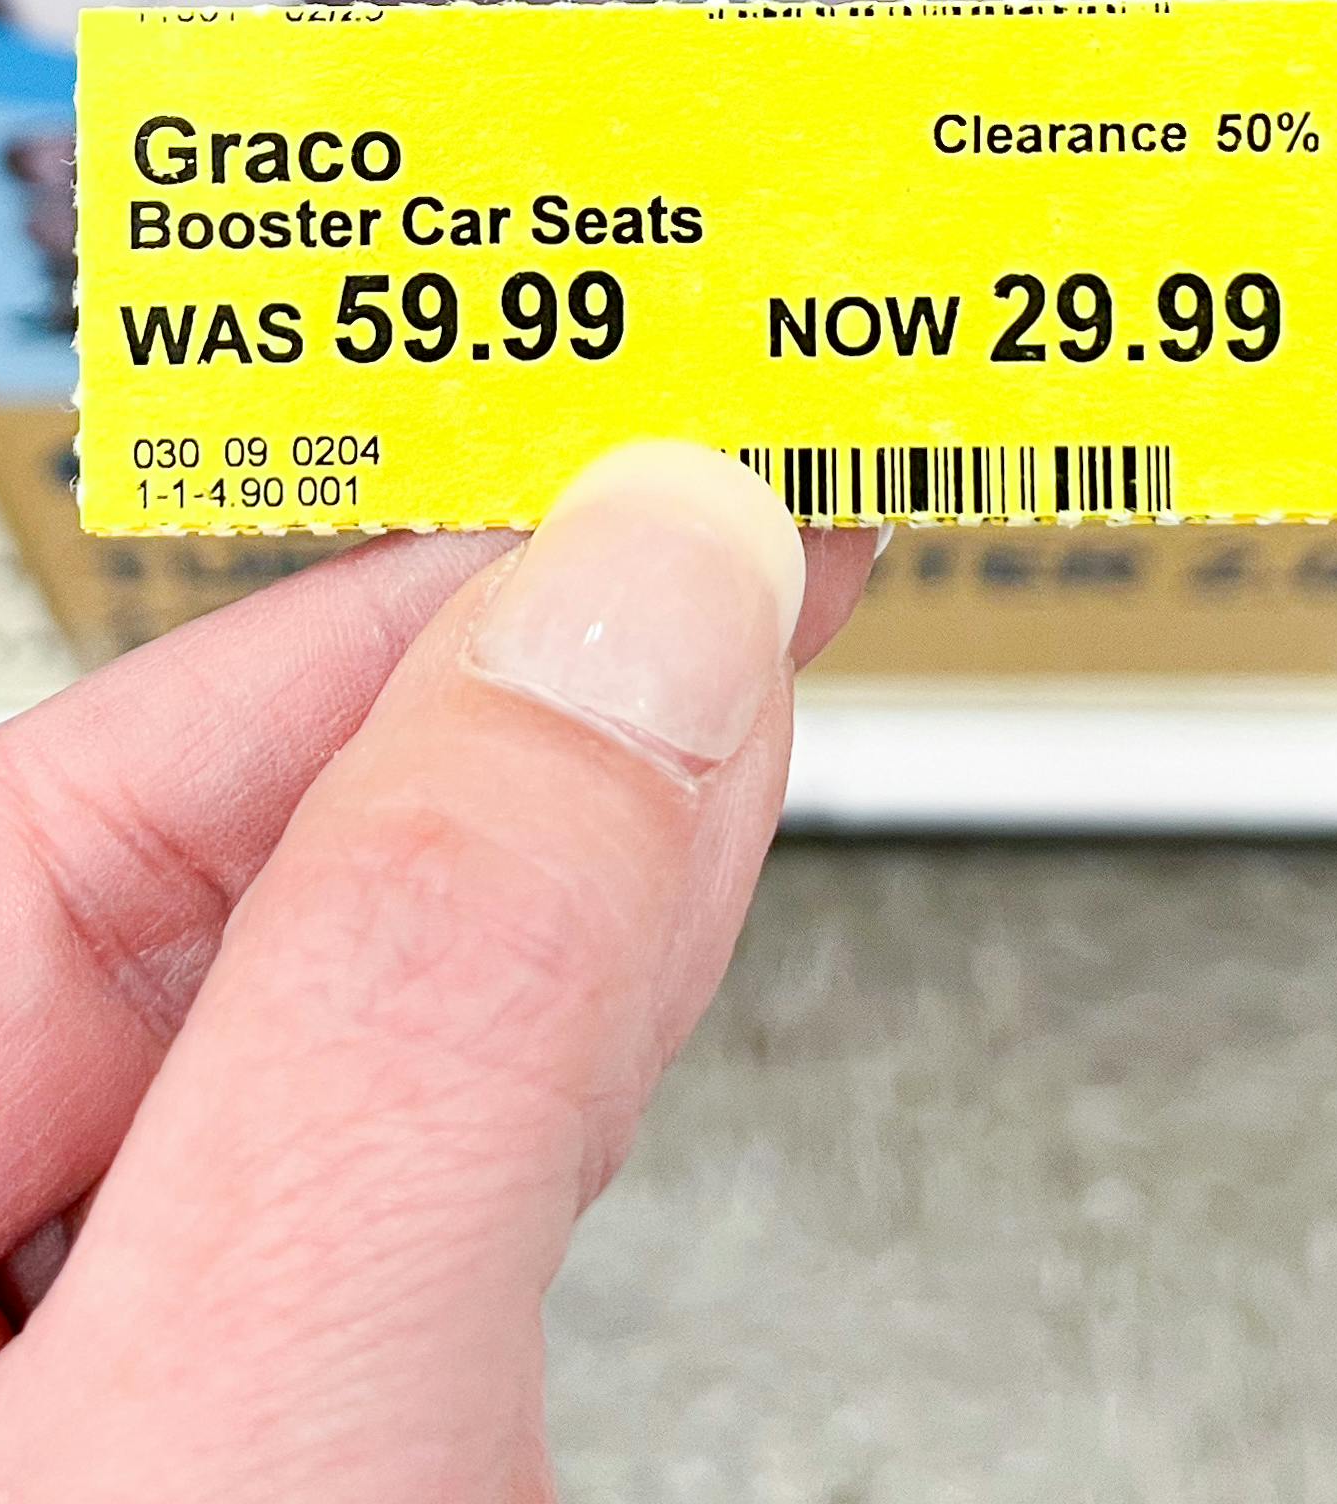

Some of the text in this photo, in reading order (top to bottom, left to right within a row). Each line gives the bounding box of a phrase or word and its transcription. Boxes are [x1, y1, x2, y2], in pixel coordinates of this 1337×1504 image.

[134, 115, 401, 186] Graco
[933, 111, 1320, 155] Clearance 50%
[130, 195, 704, 250] Booster Car Seats
[119, 270, 1282, 366] WAS 59.99 NOW 29.99
[133, 435, 381, 469] 030 09 0204
[137, 475, 359, 509] 1-1-4.90 001
